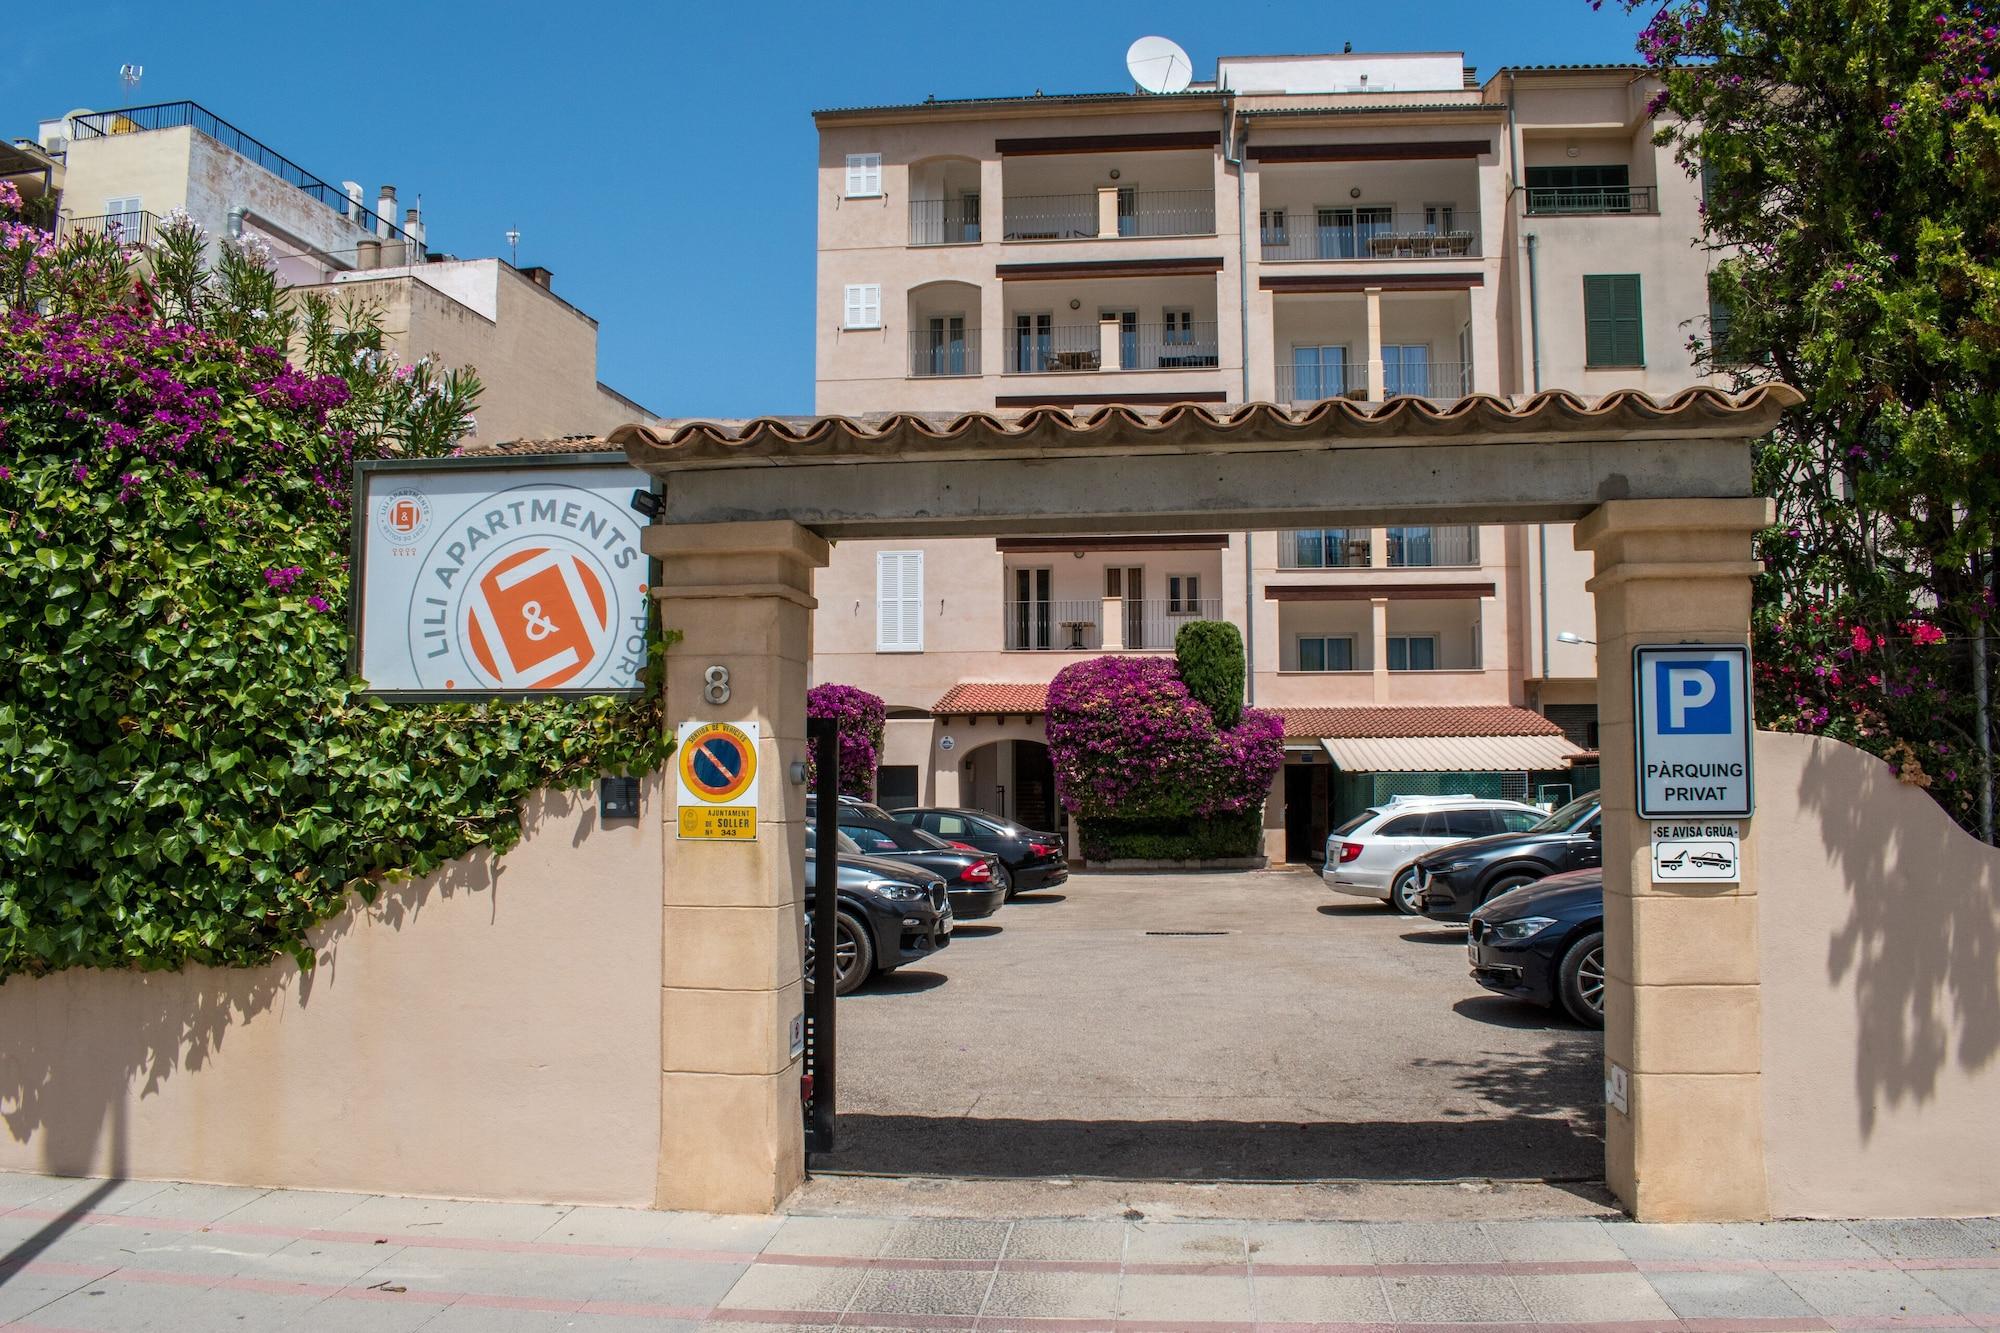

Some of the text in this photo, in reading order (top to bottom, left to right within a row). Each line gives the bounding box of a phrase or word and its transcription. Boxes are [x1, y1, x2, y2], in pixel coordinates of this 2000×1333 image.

[424, 498, 637, 658] LILI APARTMENTS
[704, 665, 731, 705] 8
[1669, 668, 1716, 728] P
[1648, 760, 1743, 778] PÀRQUING
[1665, 786, 1727, 801] PRIVAT
[707, 809, 750, 817] AJUNTAMENT
[717, 818, 750, 828] SOLLER
[1657, 823, 1733, 838] SE AVISA GRÚA
